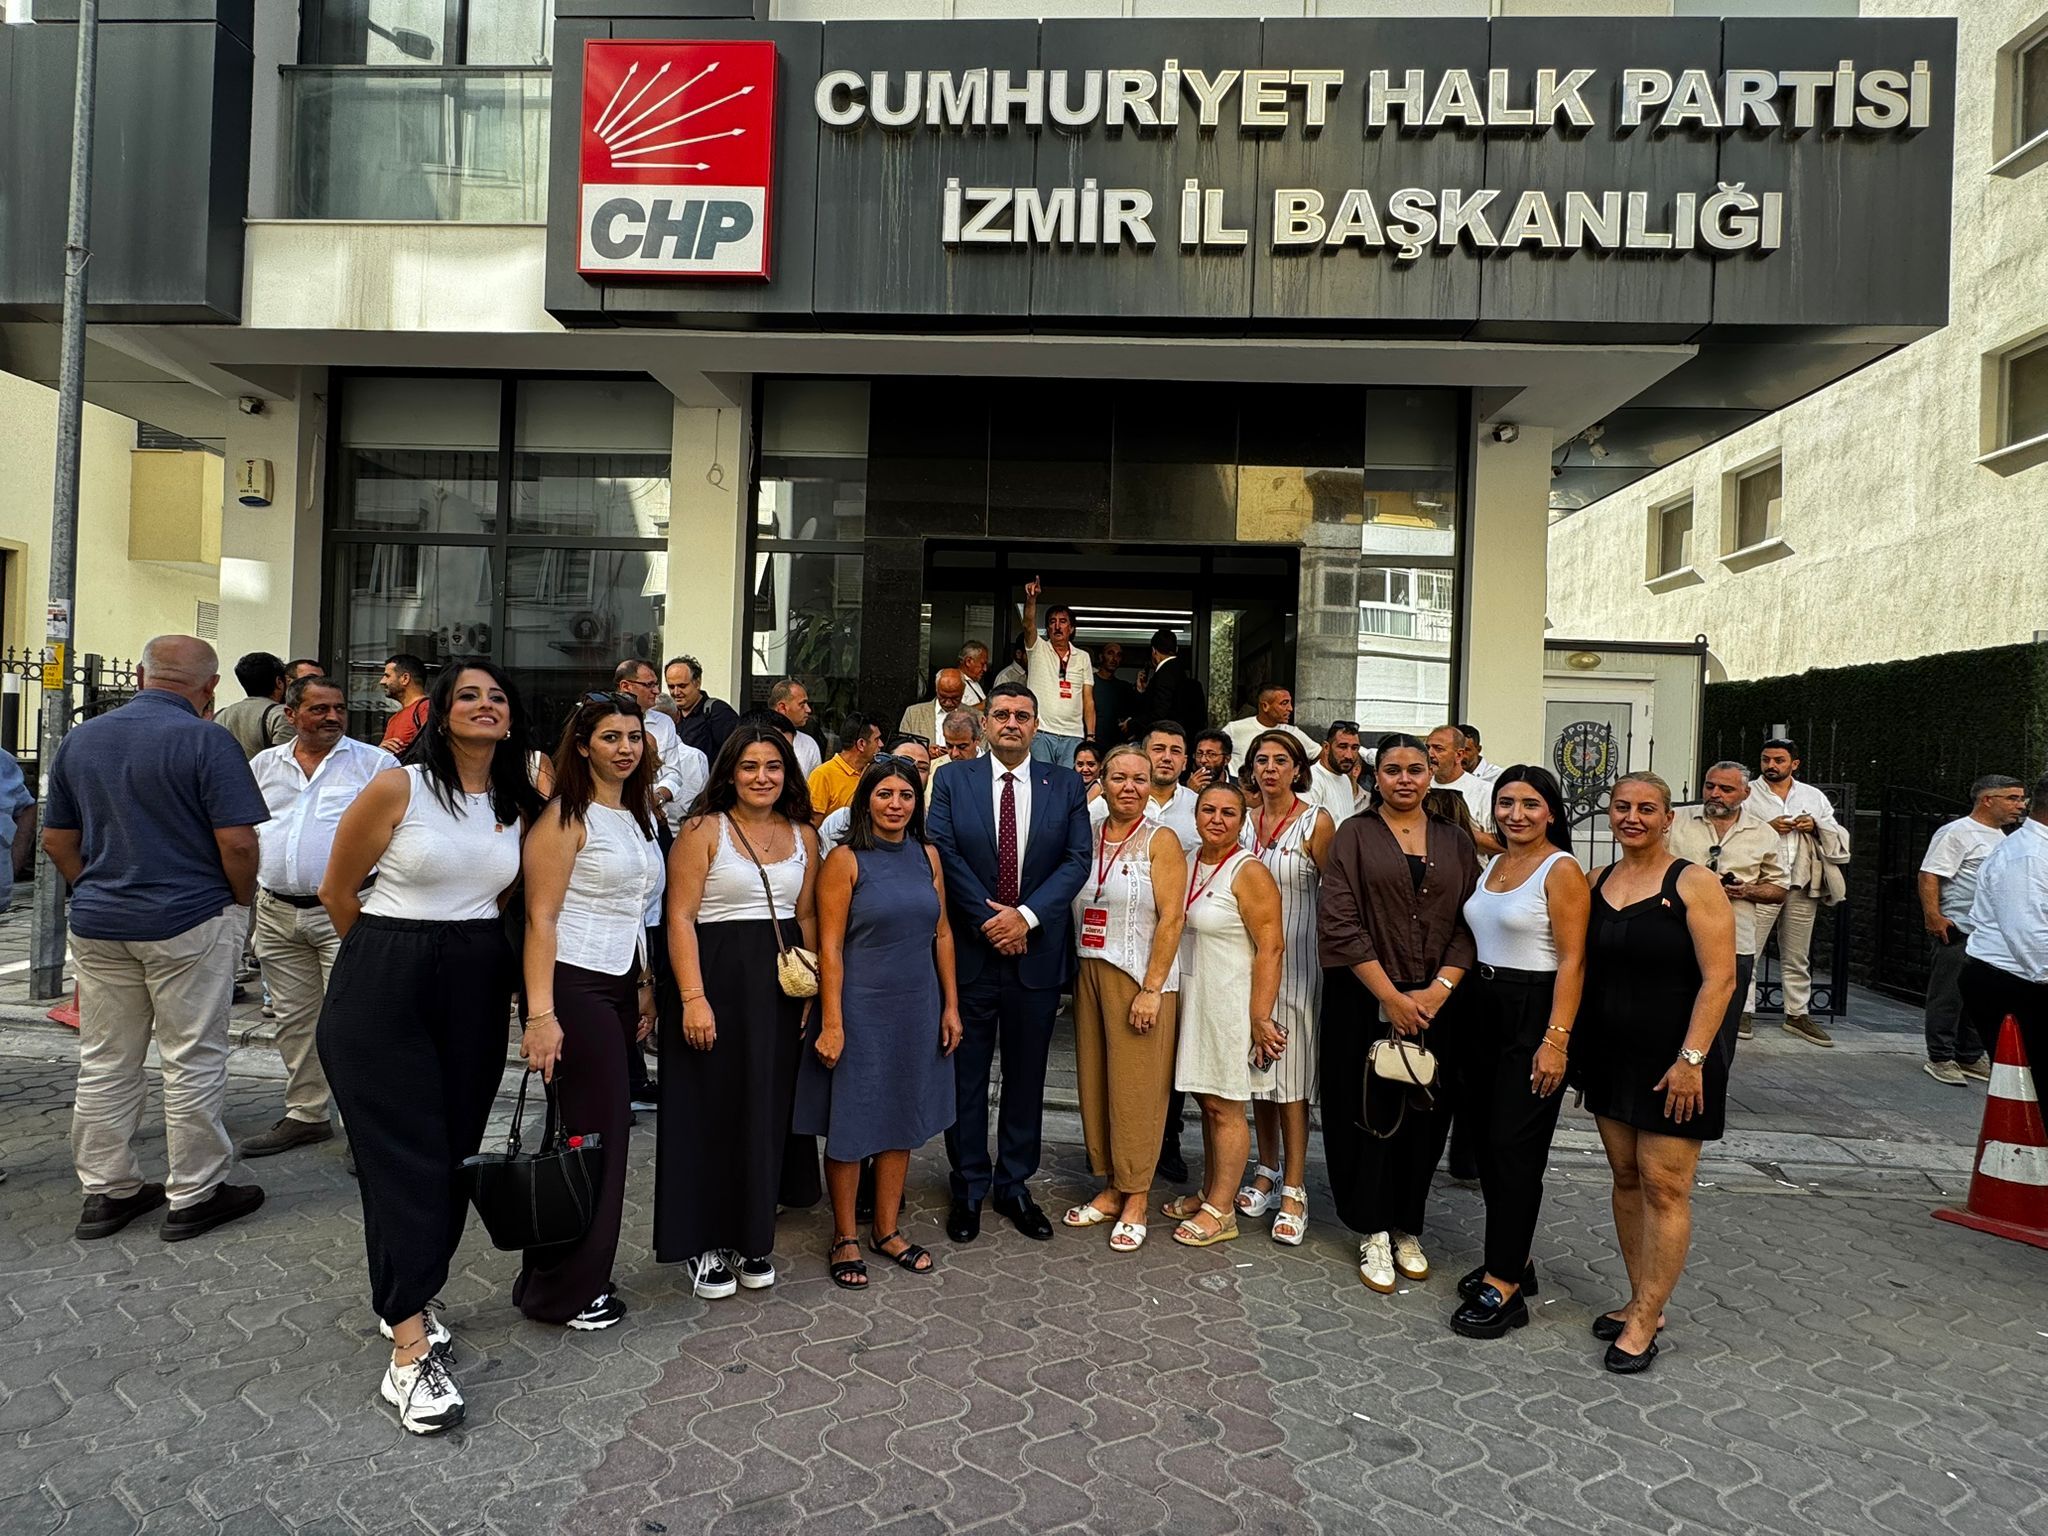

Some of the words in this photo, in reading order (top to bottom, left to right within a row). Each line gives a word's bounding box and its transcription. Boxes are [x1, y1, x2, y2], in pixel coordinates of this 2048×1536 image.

[815, 58, 1343, 129] CUMHURİYET
[1367, 68, 1597, 128] HALK
[1618, 59, 1931, 130] PARTİSİ
[590, 198, 754, 260] CHP
[941, 178, 1156, 250] İZMİR
[1180, 178, 1252, 248] İL
[1272, 182, 1784, 262] BAŞKANLIĞI
